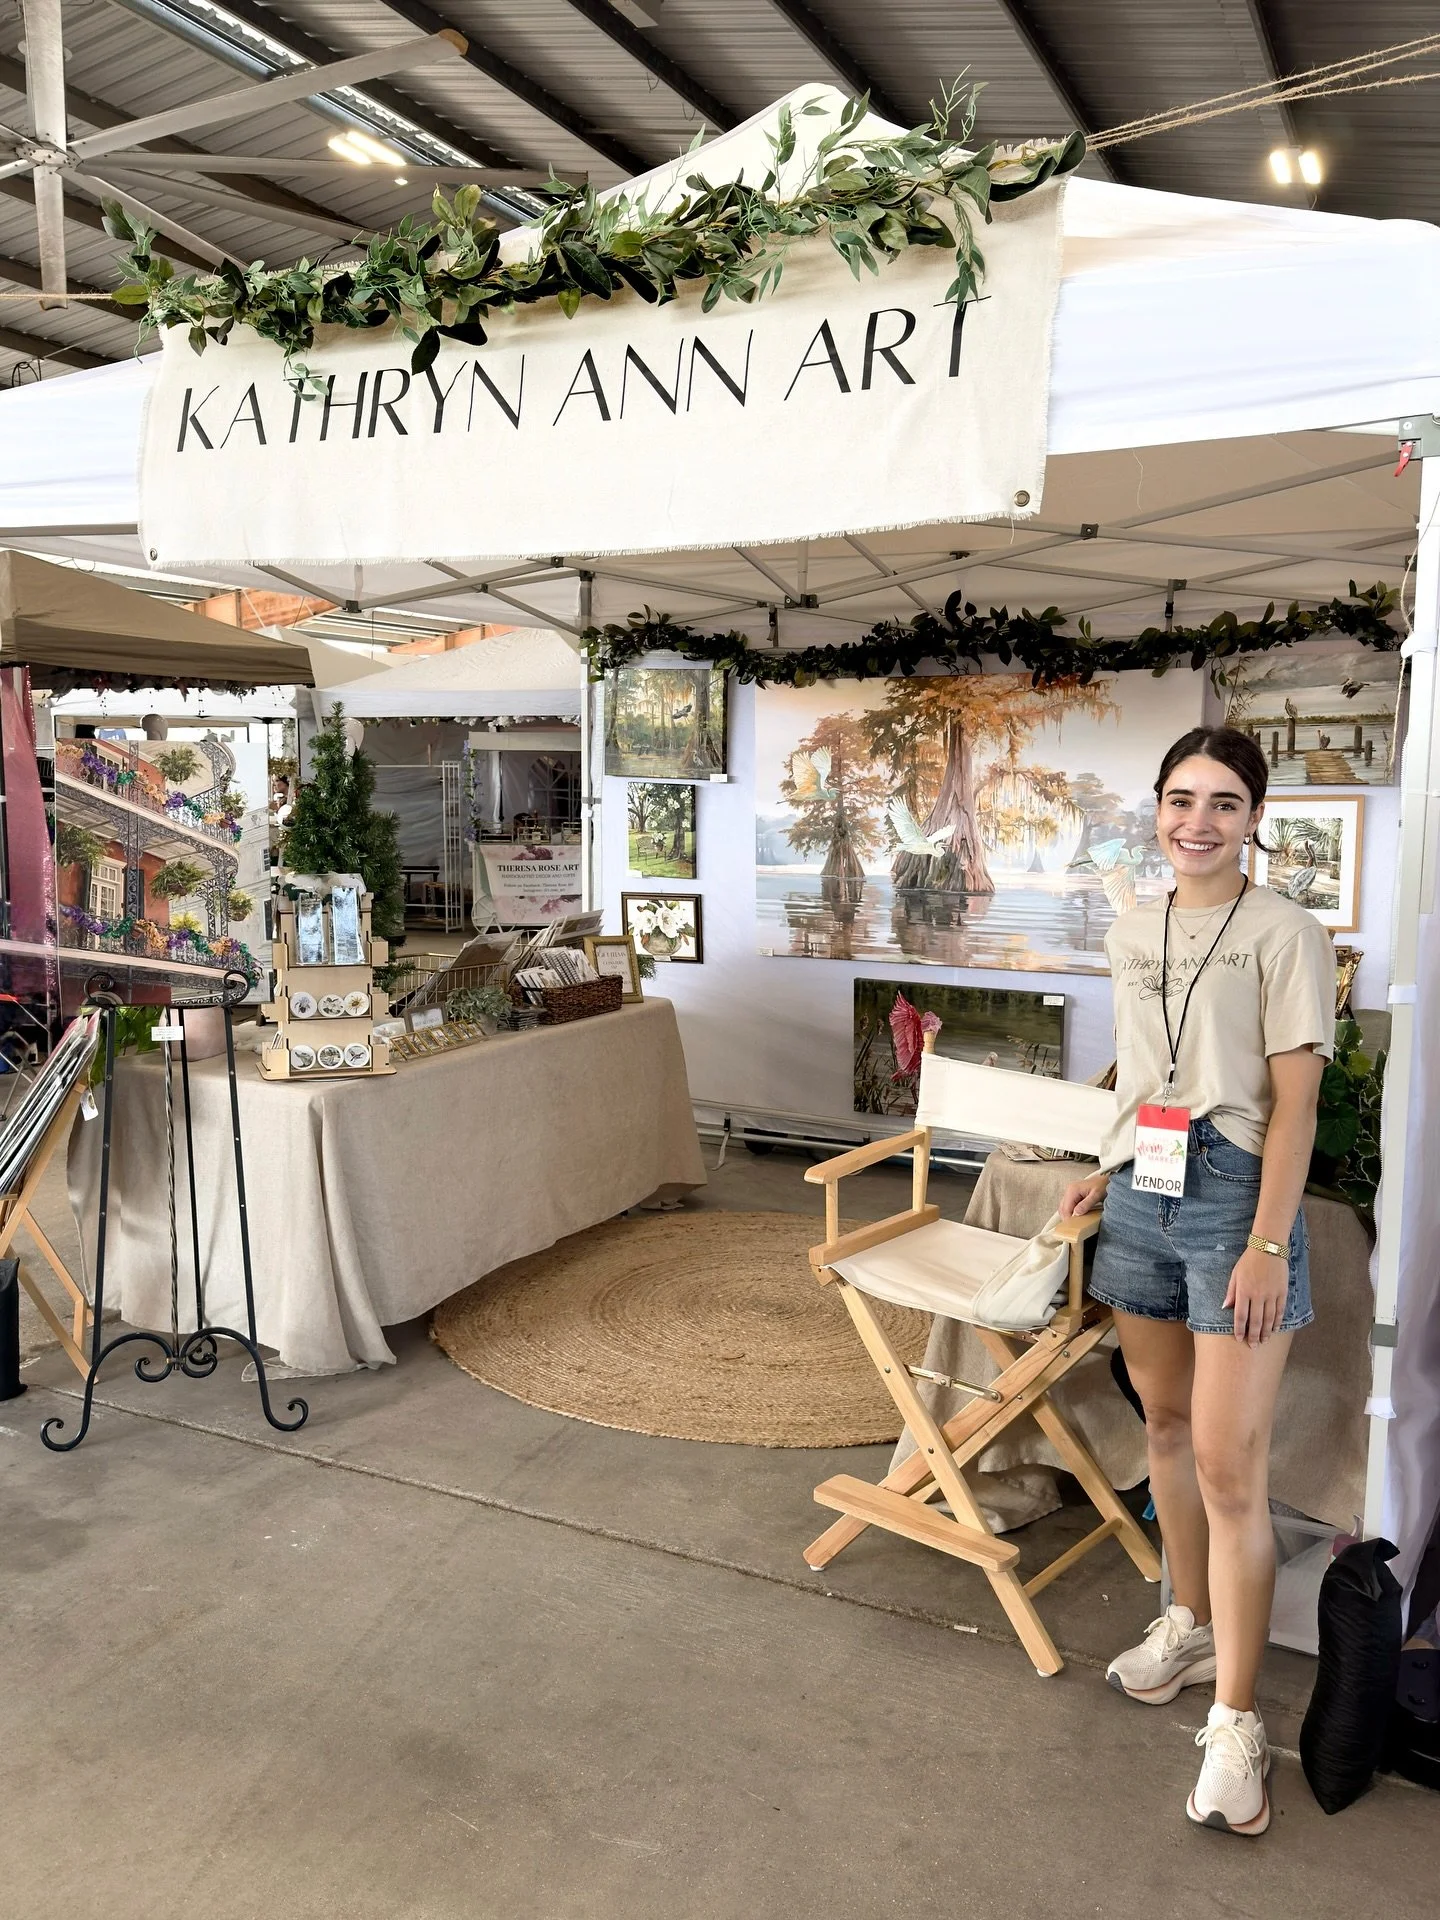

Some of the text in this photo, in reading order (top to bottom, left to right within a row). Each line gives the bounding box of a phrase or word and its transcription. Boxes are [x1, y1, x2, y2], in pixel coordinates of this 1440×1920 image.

[177, 295, 993, 453] KATHRYN ANN ART
[497, 863, 580, 872] THERESA ROSE ART
[1176, 956, 1214, 970] ANN
[1214, 953, 1252, 969] ART
[1134, 1174, 1182, 1192] VENDOR
